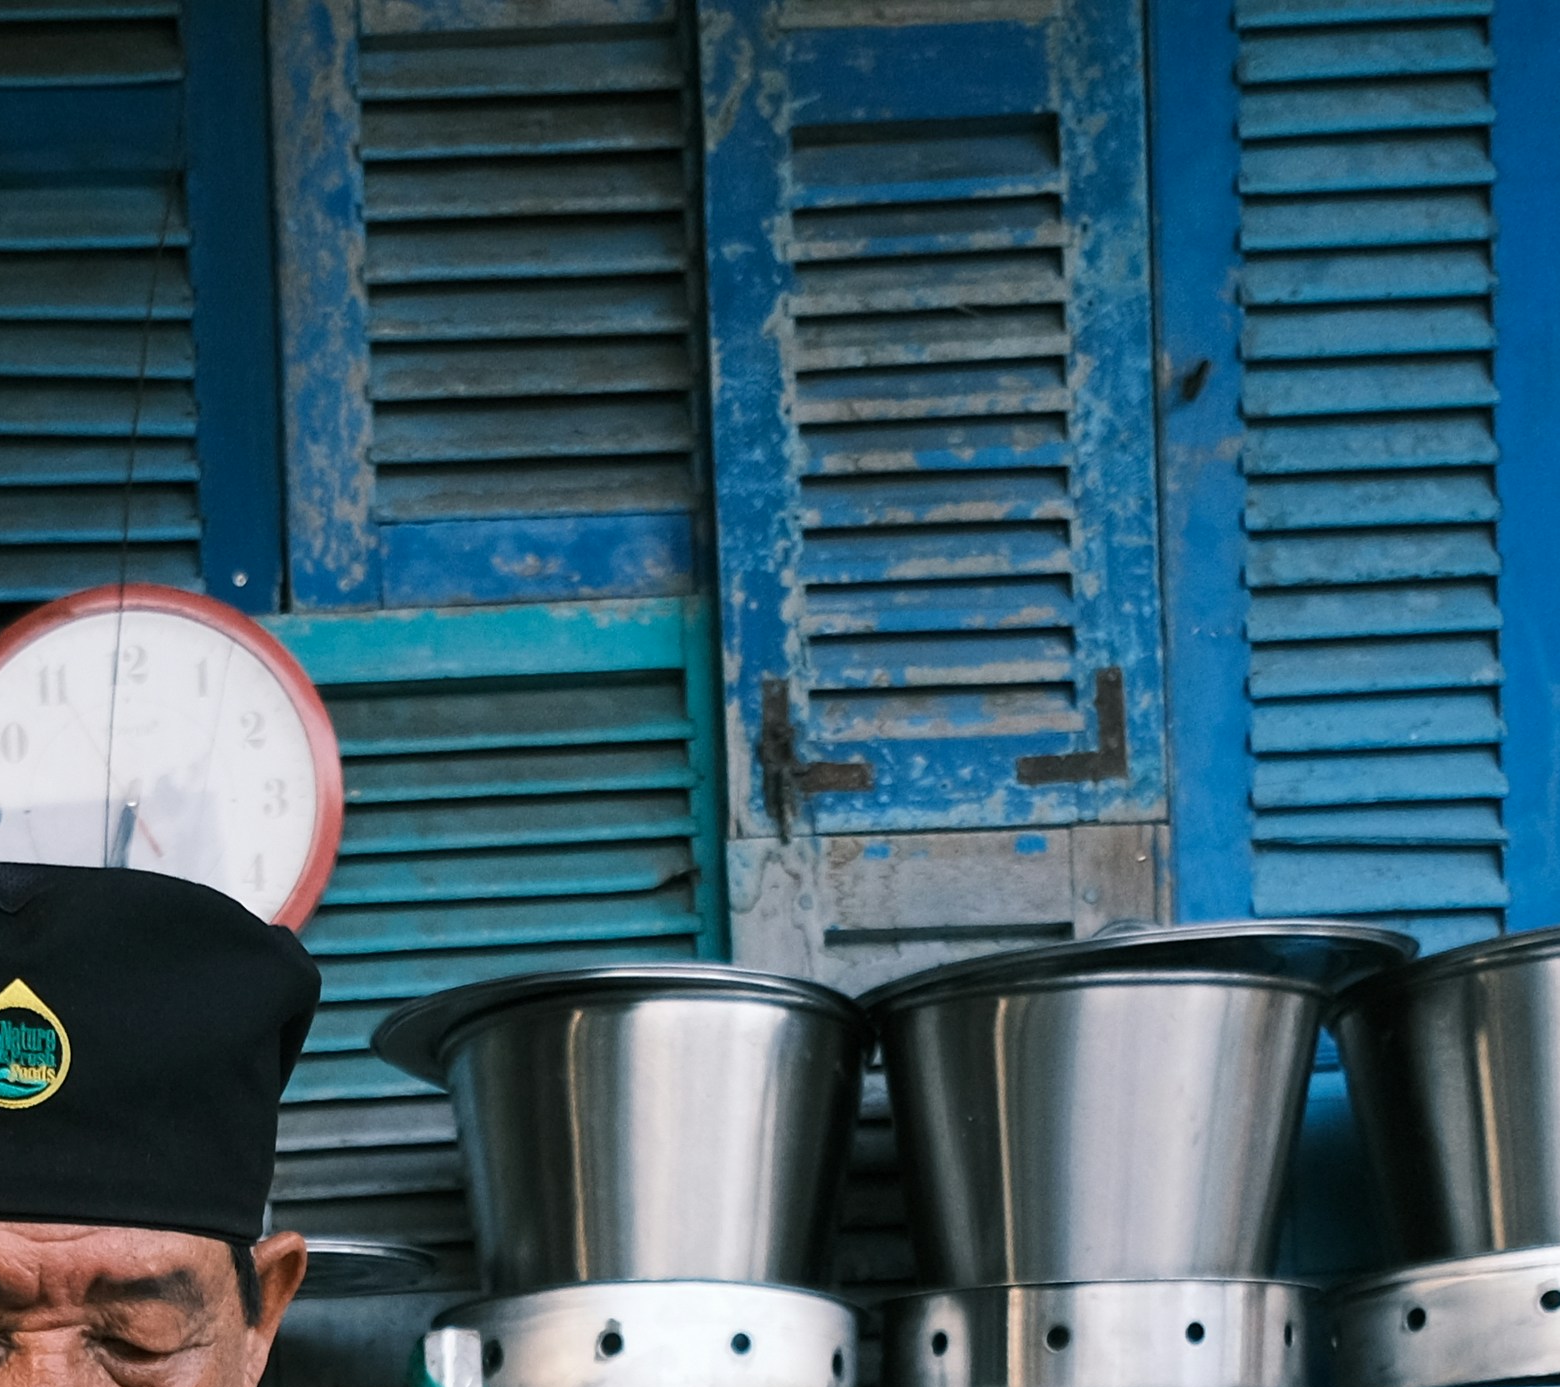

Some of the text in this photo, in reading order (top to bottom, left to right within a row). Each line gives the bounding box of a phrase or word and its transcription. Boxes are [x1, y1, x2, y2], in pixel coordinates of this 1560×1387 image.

[37, 663, 68, 706] 11
[195, 657, 209, 699] 1
[240, 711, 266, 750] 2
[263, 778, 287, 819] 3
[241, 852, 267, 893] 4
[0, 1020, 57, 1052] Nature
[9, 1063, 57, 1082] Foods
